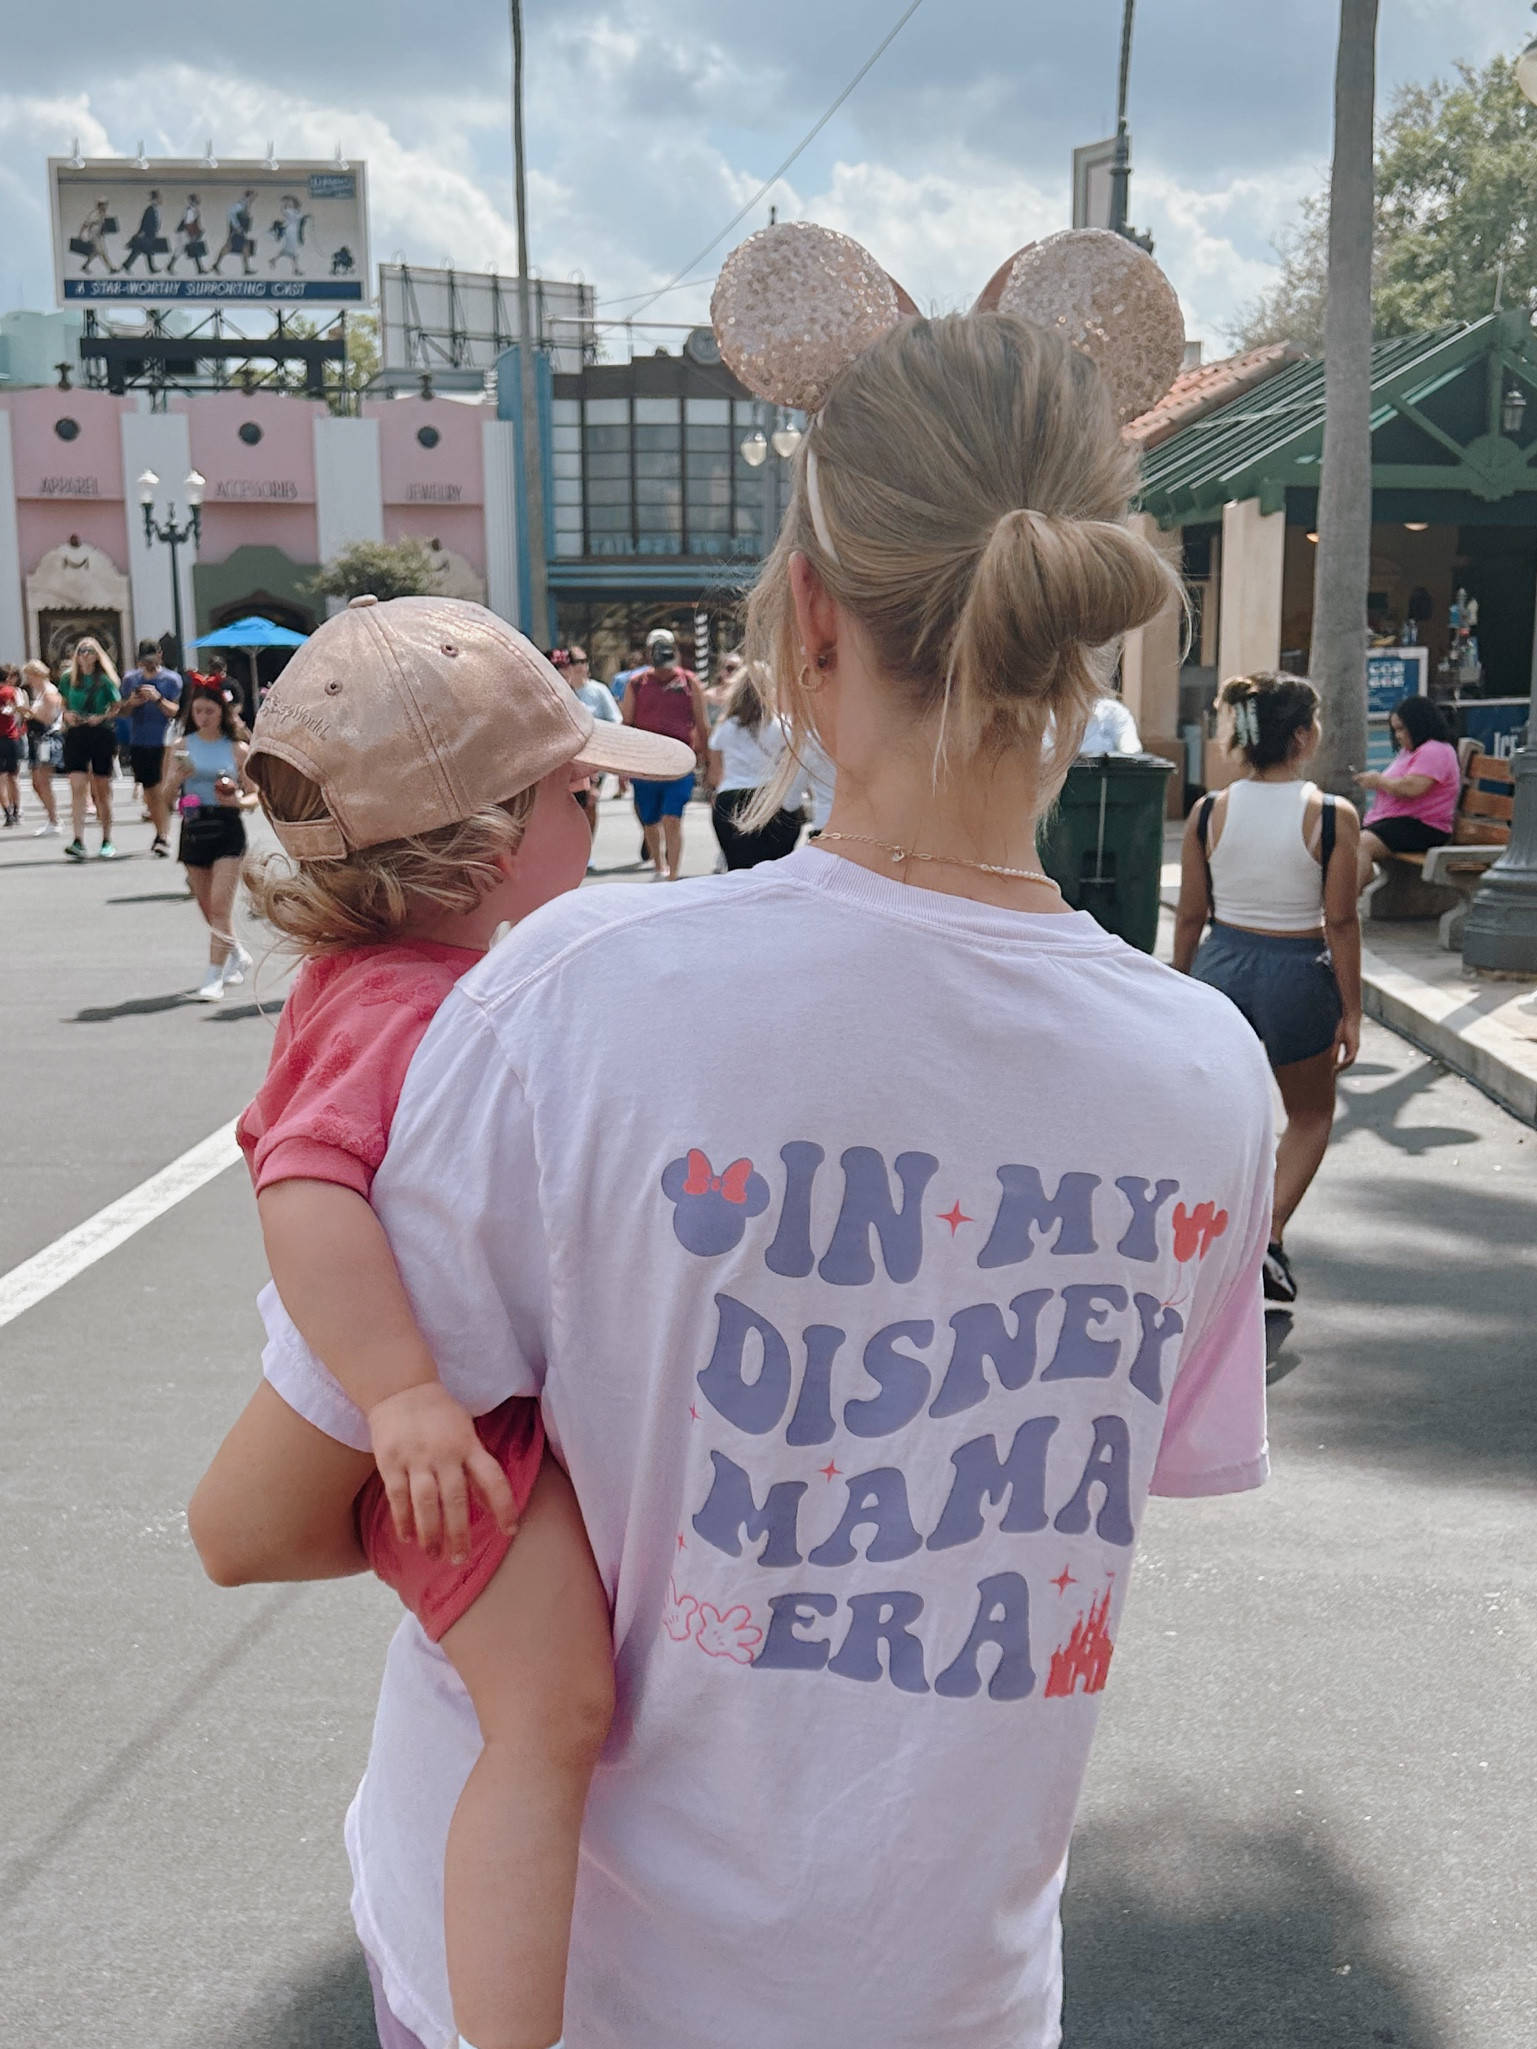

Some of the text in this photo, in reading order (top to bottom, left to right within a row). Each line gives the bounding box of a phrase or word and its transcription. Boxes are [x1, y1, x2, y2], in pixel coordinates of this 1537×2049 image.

[75, 281, 307, 297] A STAR-WORTHY SUPPORTING CAST
[40, 477, 100, 496] APPAREL
[215, 479, 298, 499] ACCESSORIES
[765, 1141, 1180, 1286] IN MY
[697, 1285, 1184, 1447] DISNEY
[692, 1416, 1134, 1567] MAMA
[751, 1571, 1037, 1701] ERA
